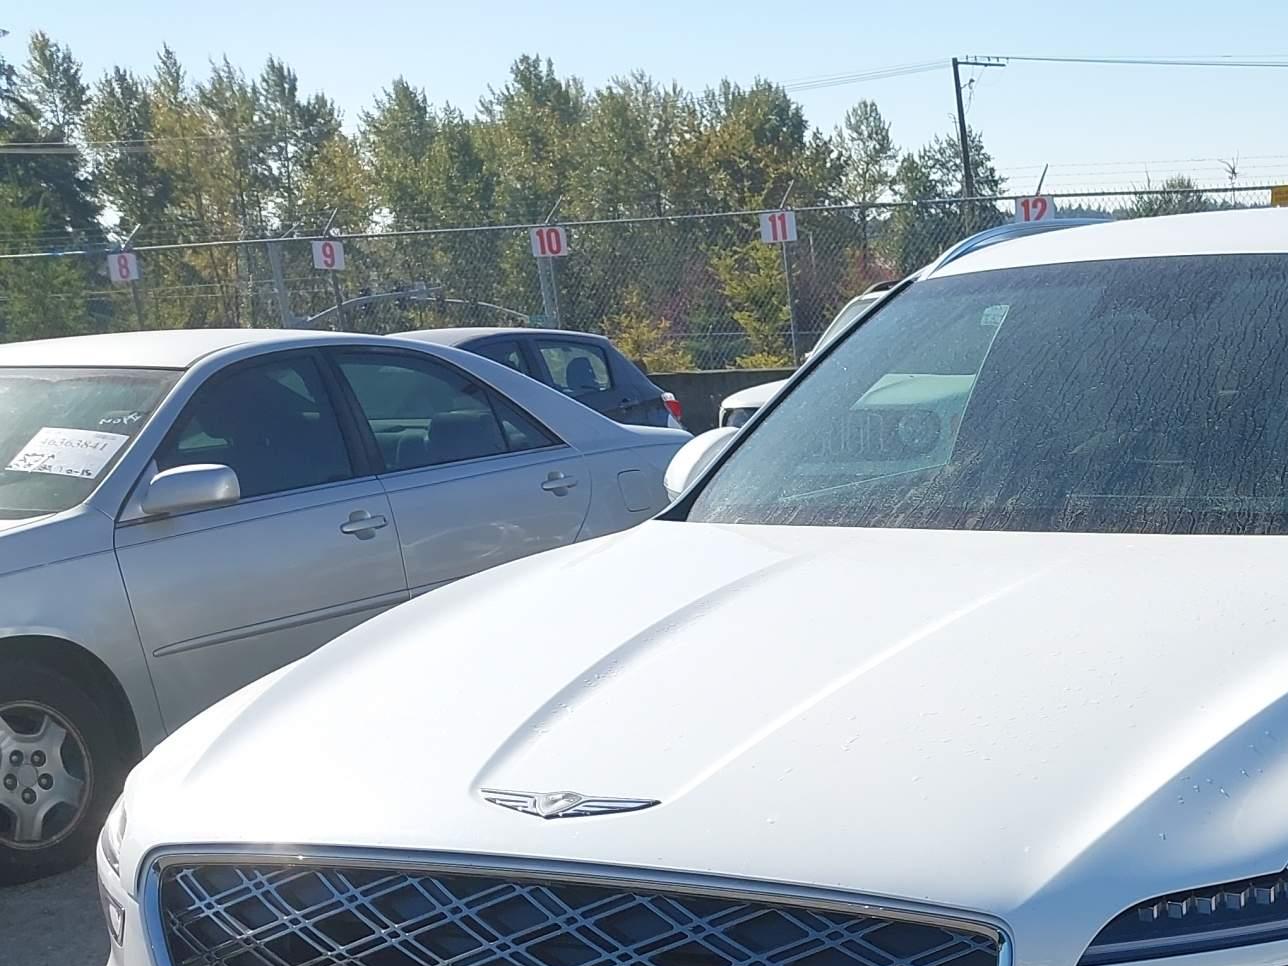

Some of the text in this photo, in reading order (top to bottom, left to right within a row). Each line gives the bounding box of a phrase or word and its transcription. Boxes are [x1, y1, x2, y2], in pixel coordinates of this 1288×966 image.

[1021, 197, 1047, 221] 12
[768, 213, 788, 241] 11
[536, 228, 561, 255] 10
[118, 254, 129, 279] 8
[322, 242, 335, 267] 9
